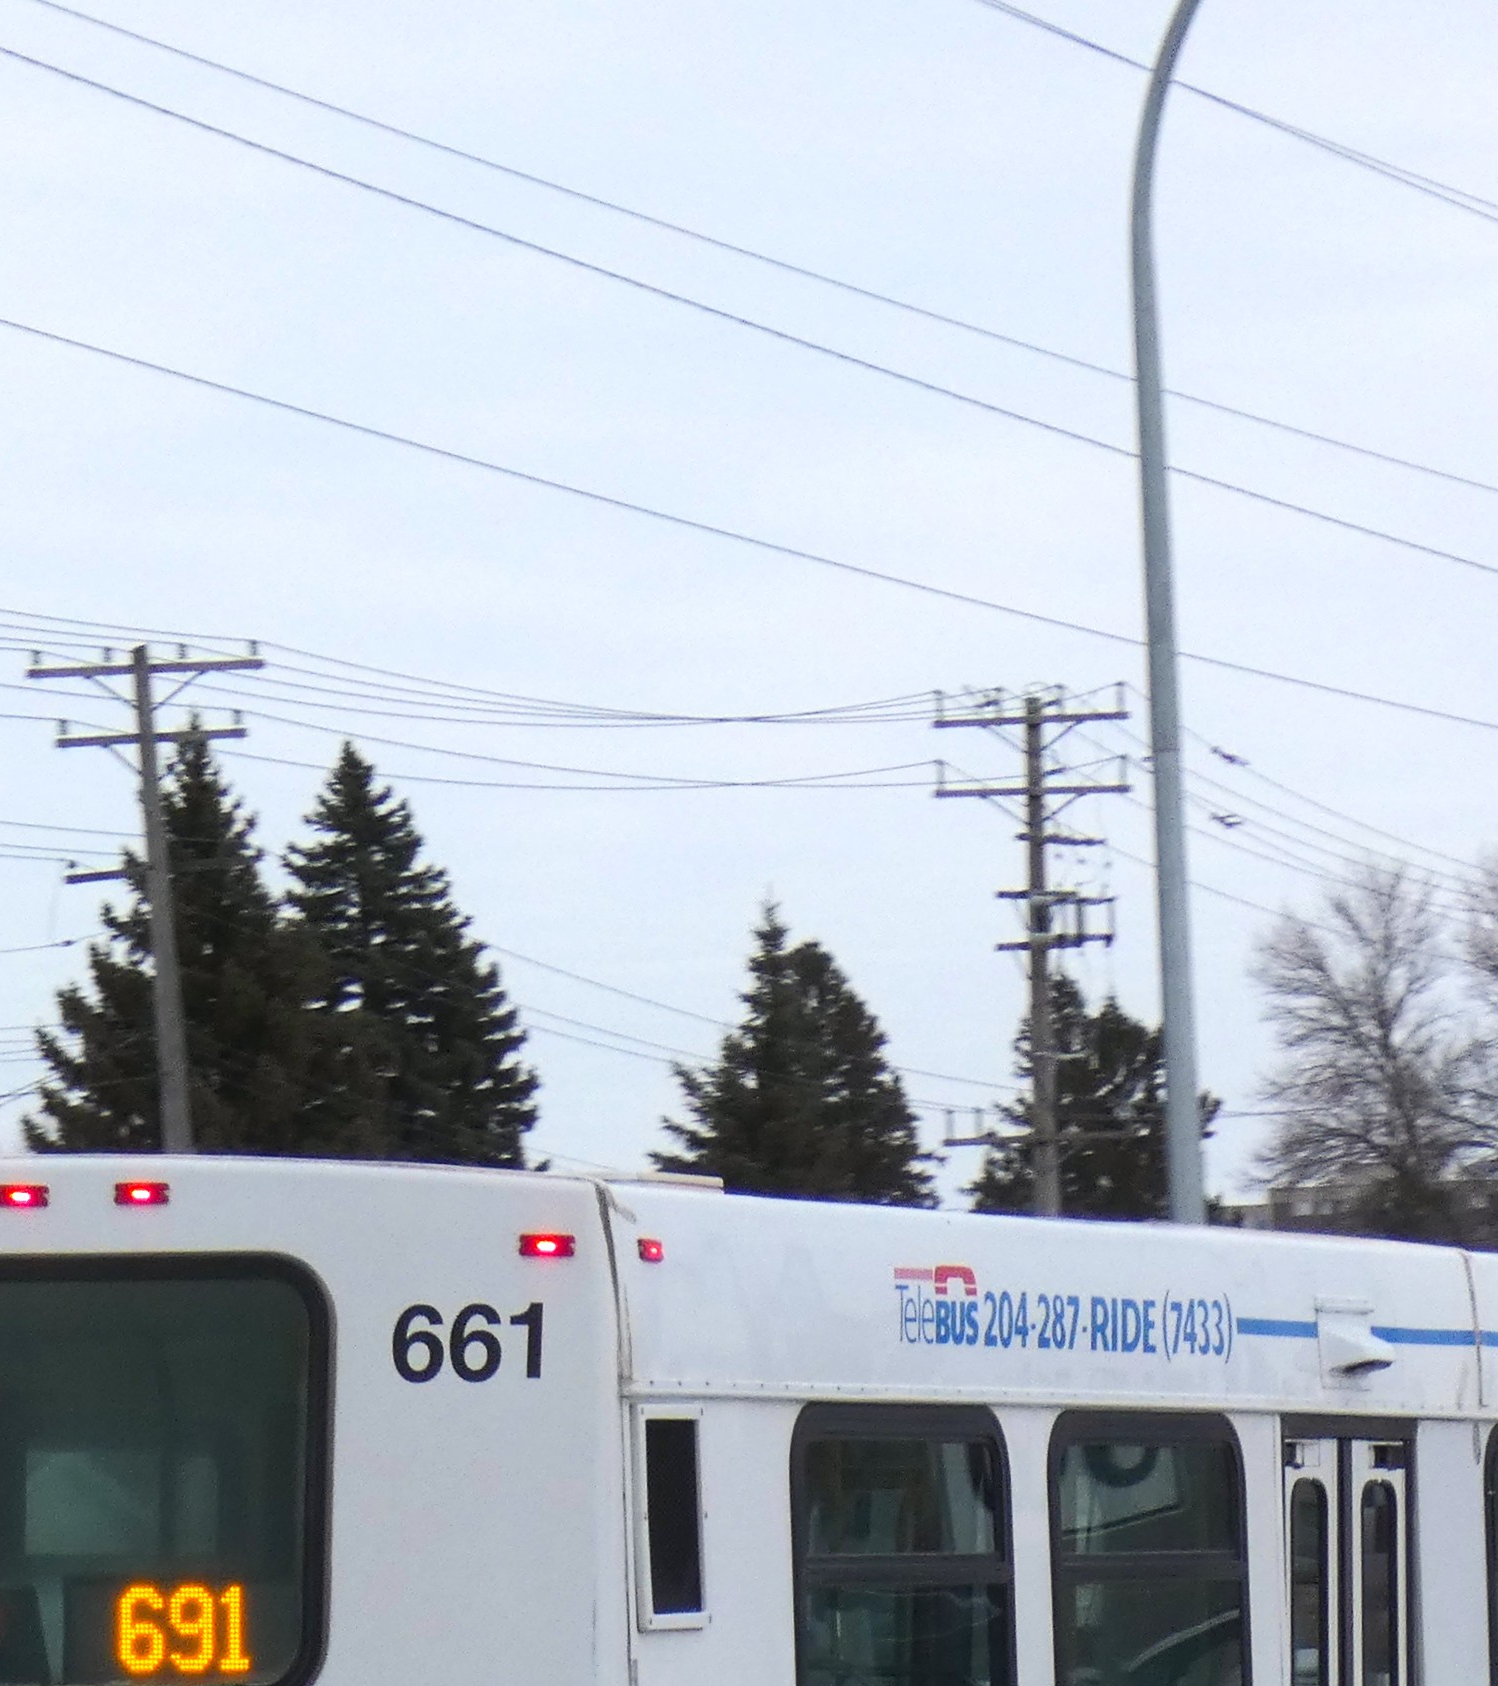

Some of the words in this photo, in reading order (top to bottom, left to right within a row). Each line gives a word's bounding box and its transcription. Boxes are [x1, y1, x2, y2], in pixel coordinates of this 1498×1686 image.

[392, 1302, 545, 1383] 661
[895, 1284, 979, 1345] TeleBUS
[1163, 1289, 1232, 1364] (7433)
[116, 1583, 250, 1674] 691
